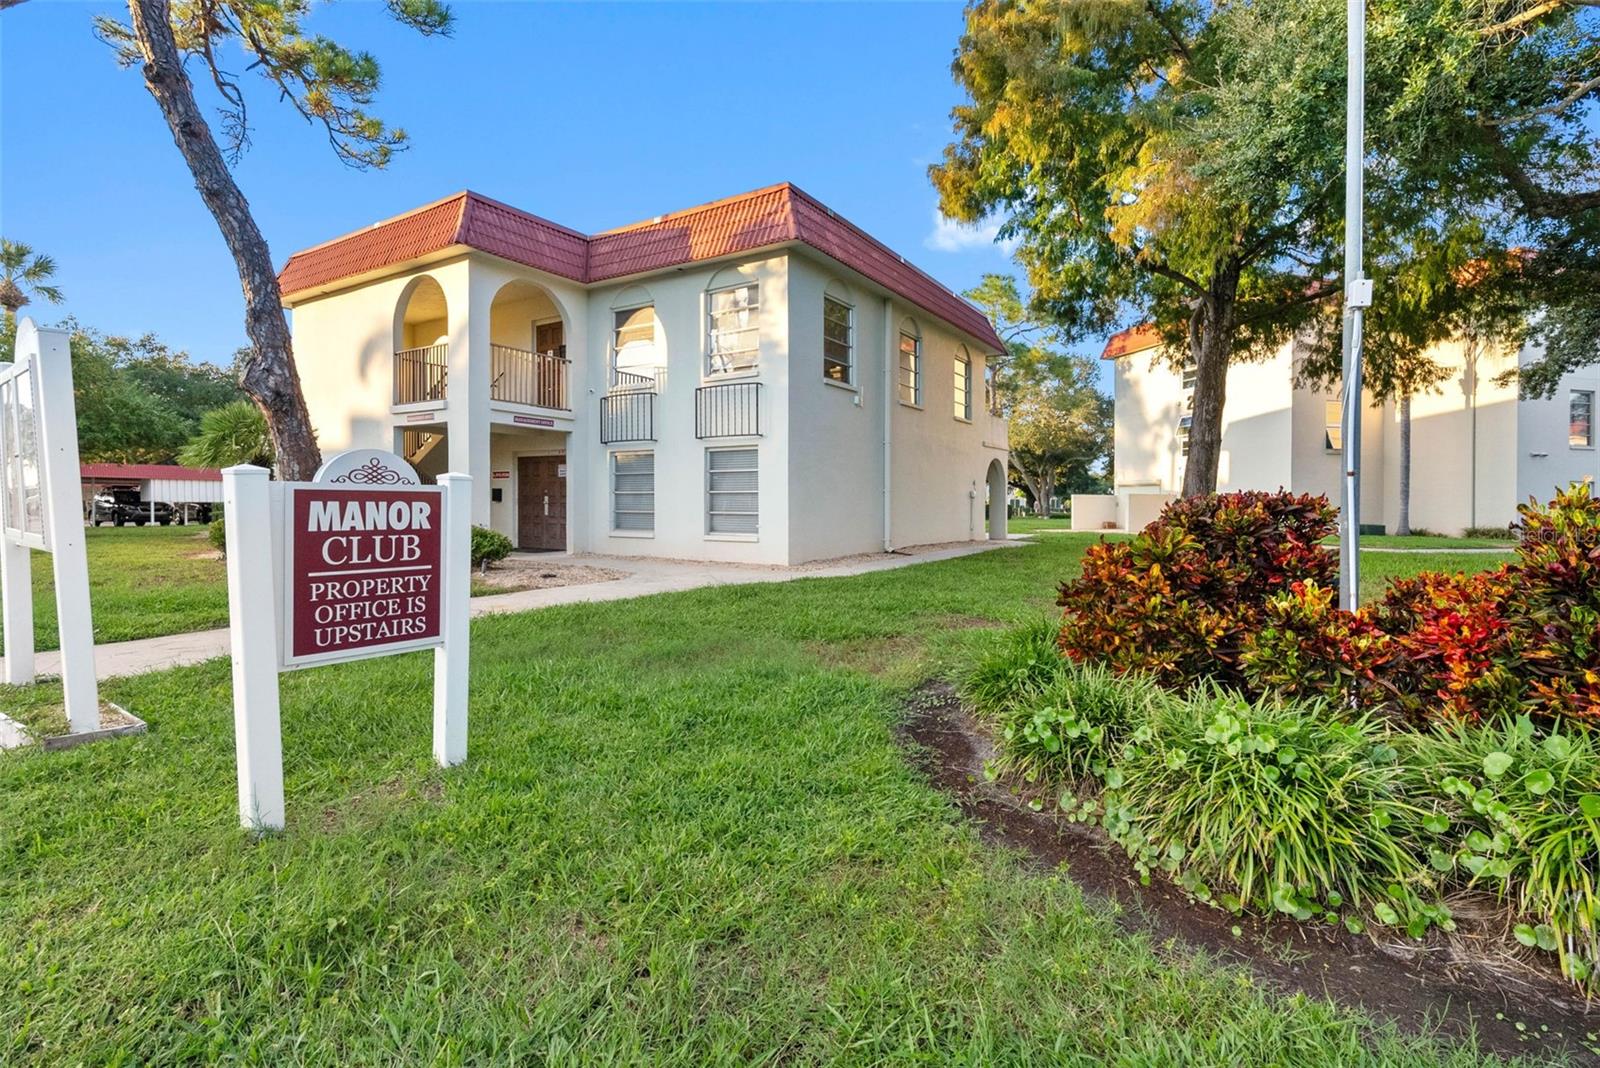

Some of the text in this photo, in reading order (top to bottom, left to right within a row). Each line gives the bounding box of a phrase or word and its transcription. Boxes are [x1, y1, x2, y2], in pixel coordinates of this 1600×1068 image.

[308, 501, 431, 532] MANOR
[322, 535, 421, 565] CLUB
[310, 575, 432, 601] PROPERTY
[315, 596, 426, 624] OFFICE IS
[314, 616, 426, 647] UPSTAIRS
